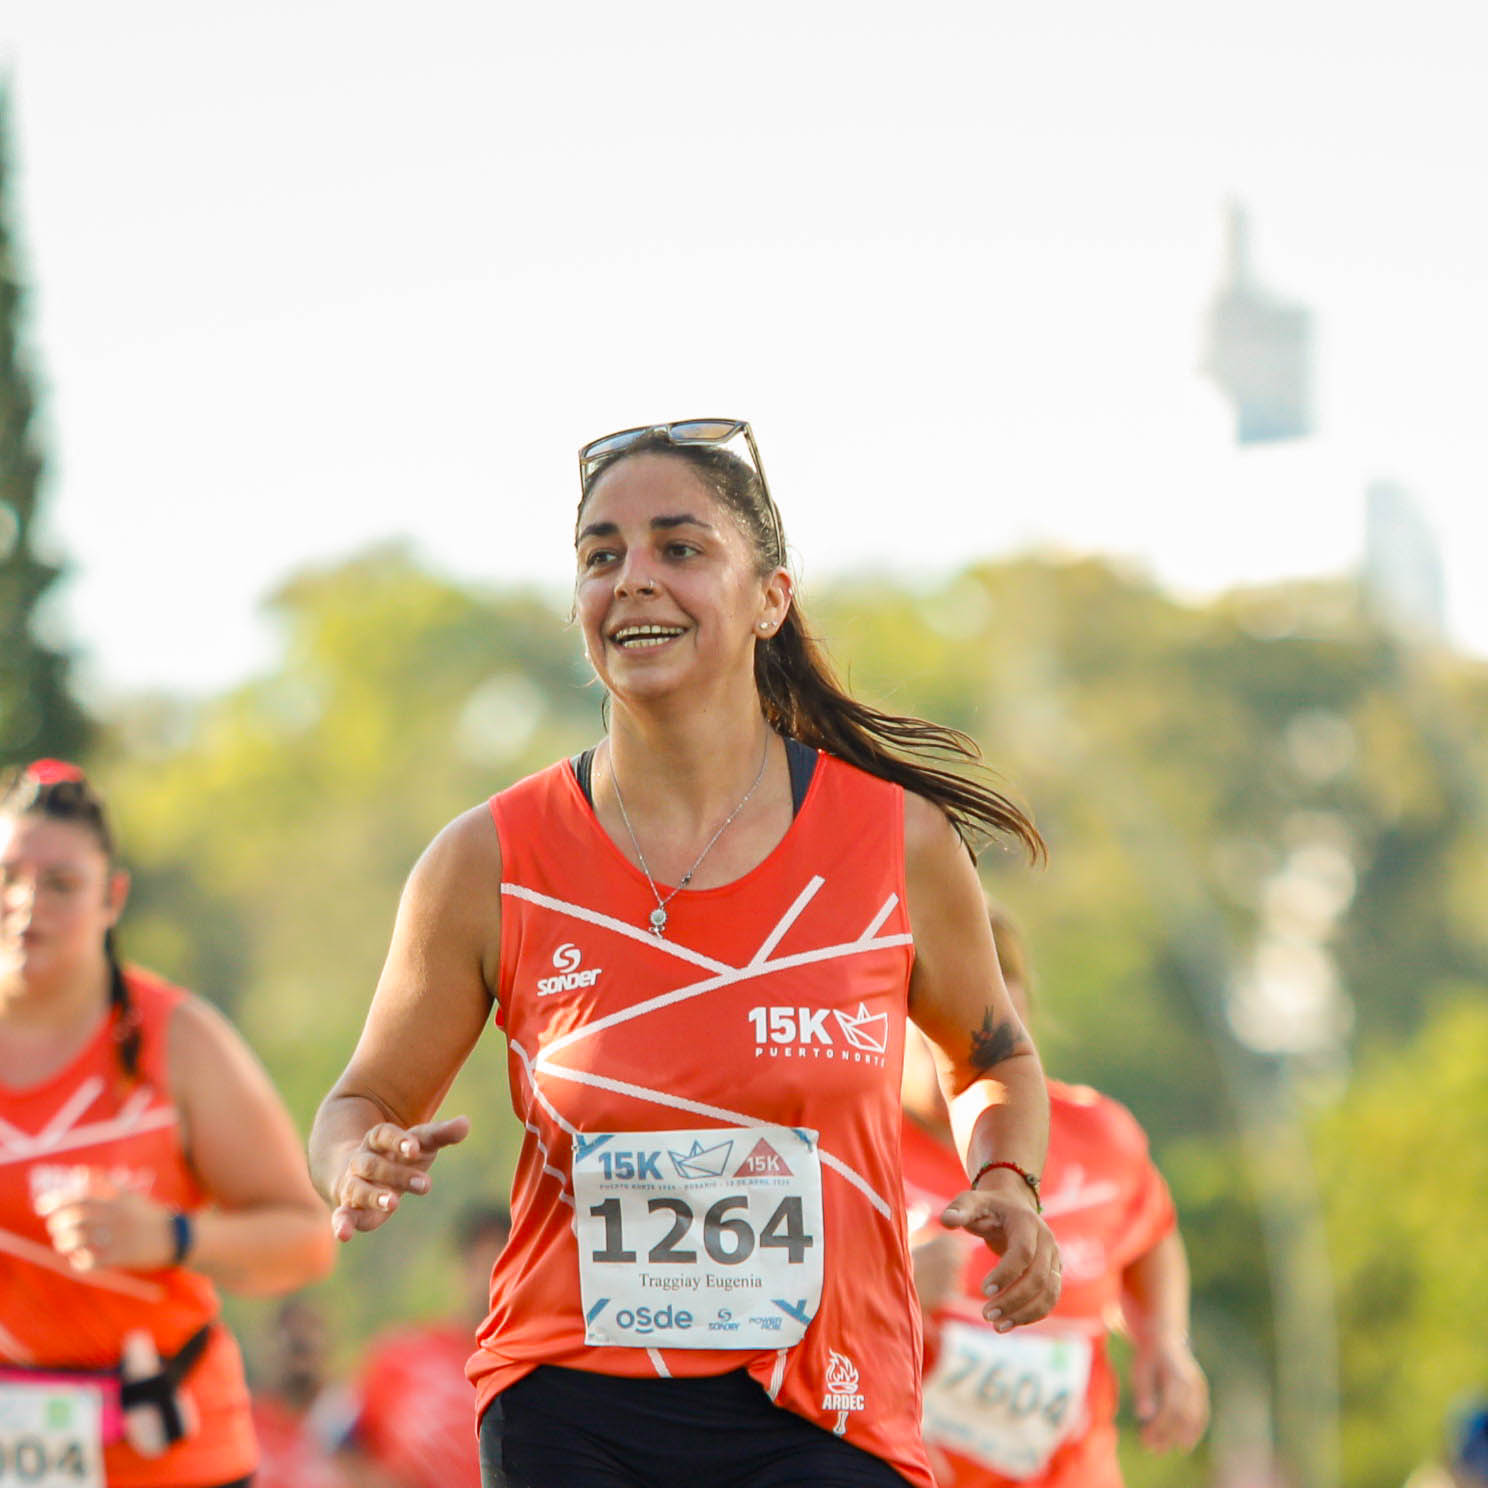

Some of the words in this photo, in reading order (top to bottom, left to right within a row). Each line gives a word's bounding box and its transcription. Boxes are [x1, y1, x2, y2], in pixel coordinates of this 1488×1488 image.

[748, 1006, 833, 1044] 15K
[755, 1047, 834, 1058] PUERTO
[598, 1150, 664, 1180] 15K
[746, 1155, 780, 1172] 15K
[590, 1195, 814, 1265] 1264
[706, 1274, 763, 1291] Eugenia
[616, 1304, 694, 1331] osde
[822, 1394, 865, 1411] ARDEC
